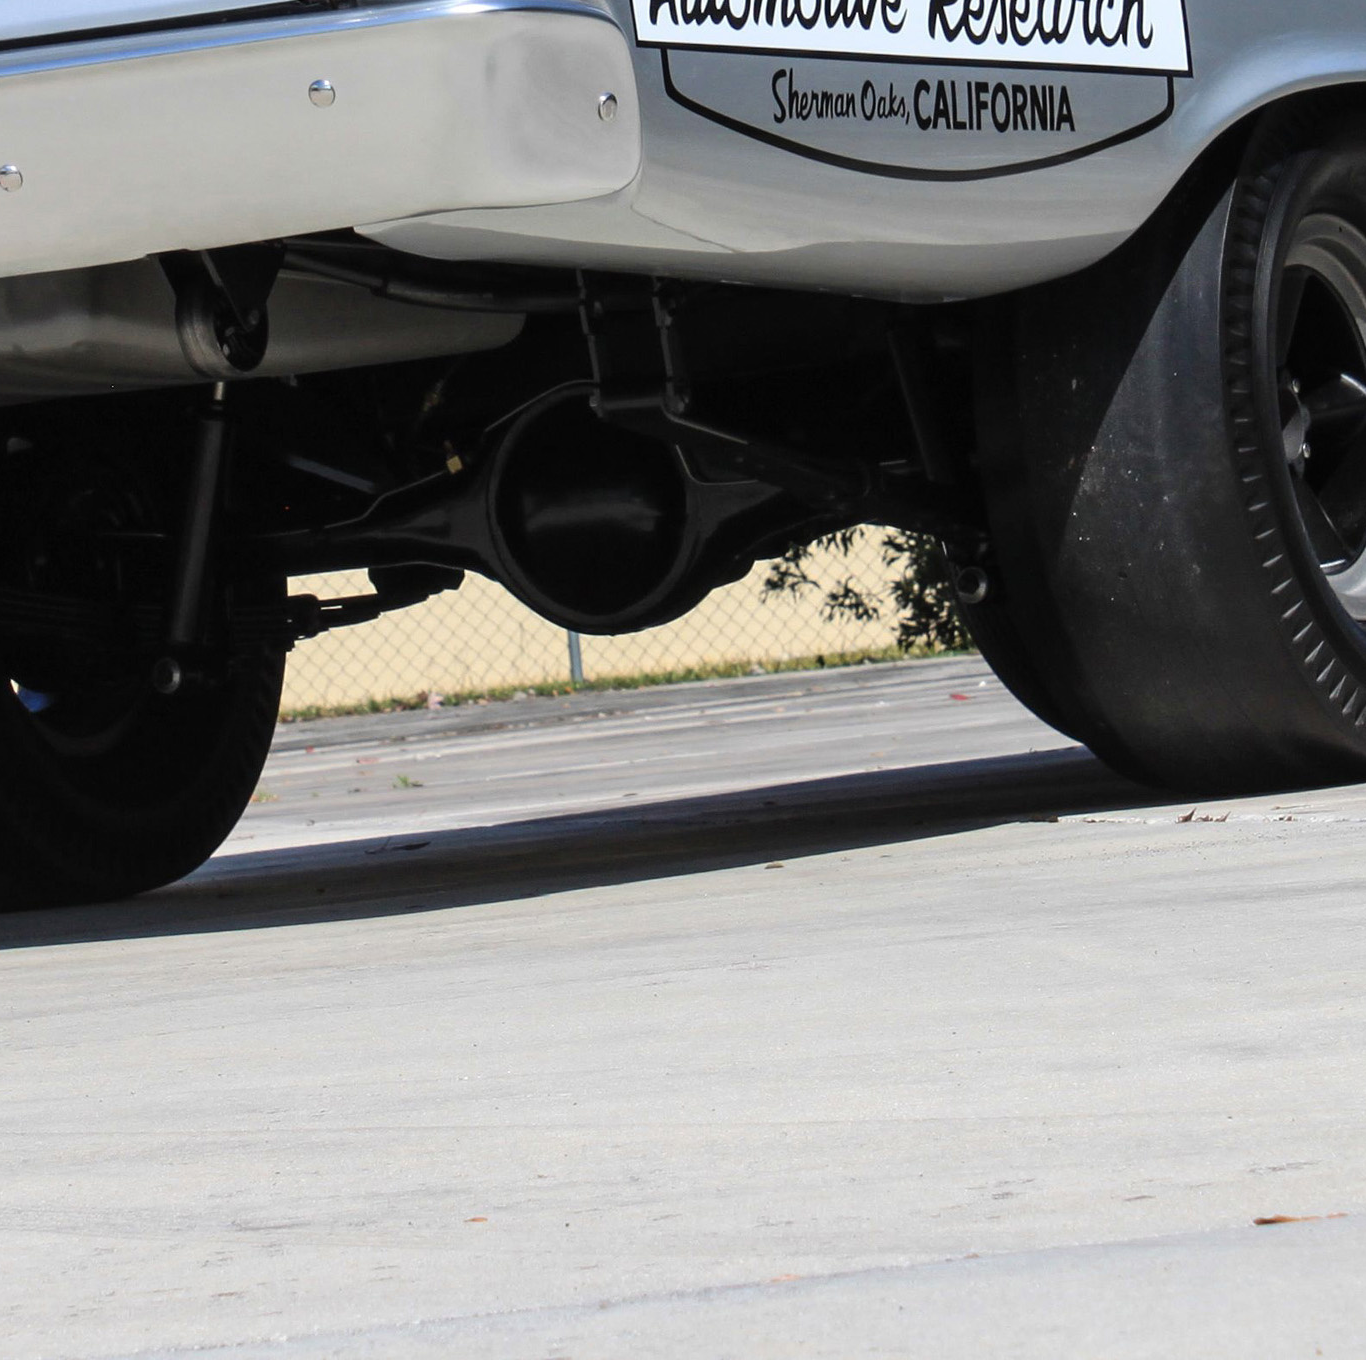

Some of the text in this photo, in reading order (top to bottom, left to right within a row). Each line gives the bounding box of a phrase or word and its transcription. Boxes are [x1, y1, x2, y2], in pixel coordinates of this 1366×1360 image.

[772, 68, 1075, 132] Sherman Oaks, CALIFORNIA
